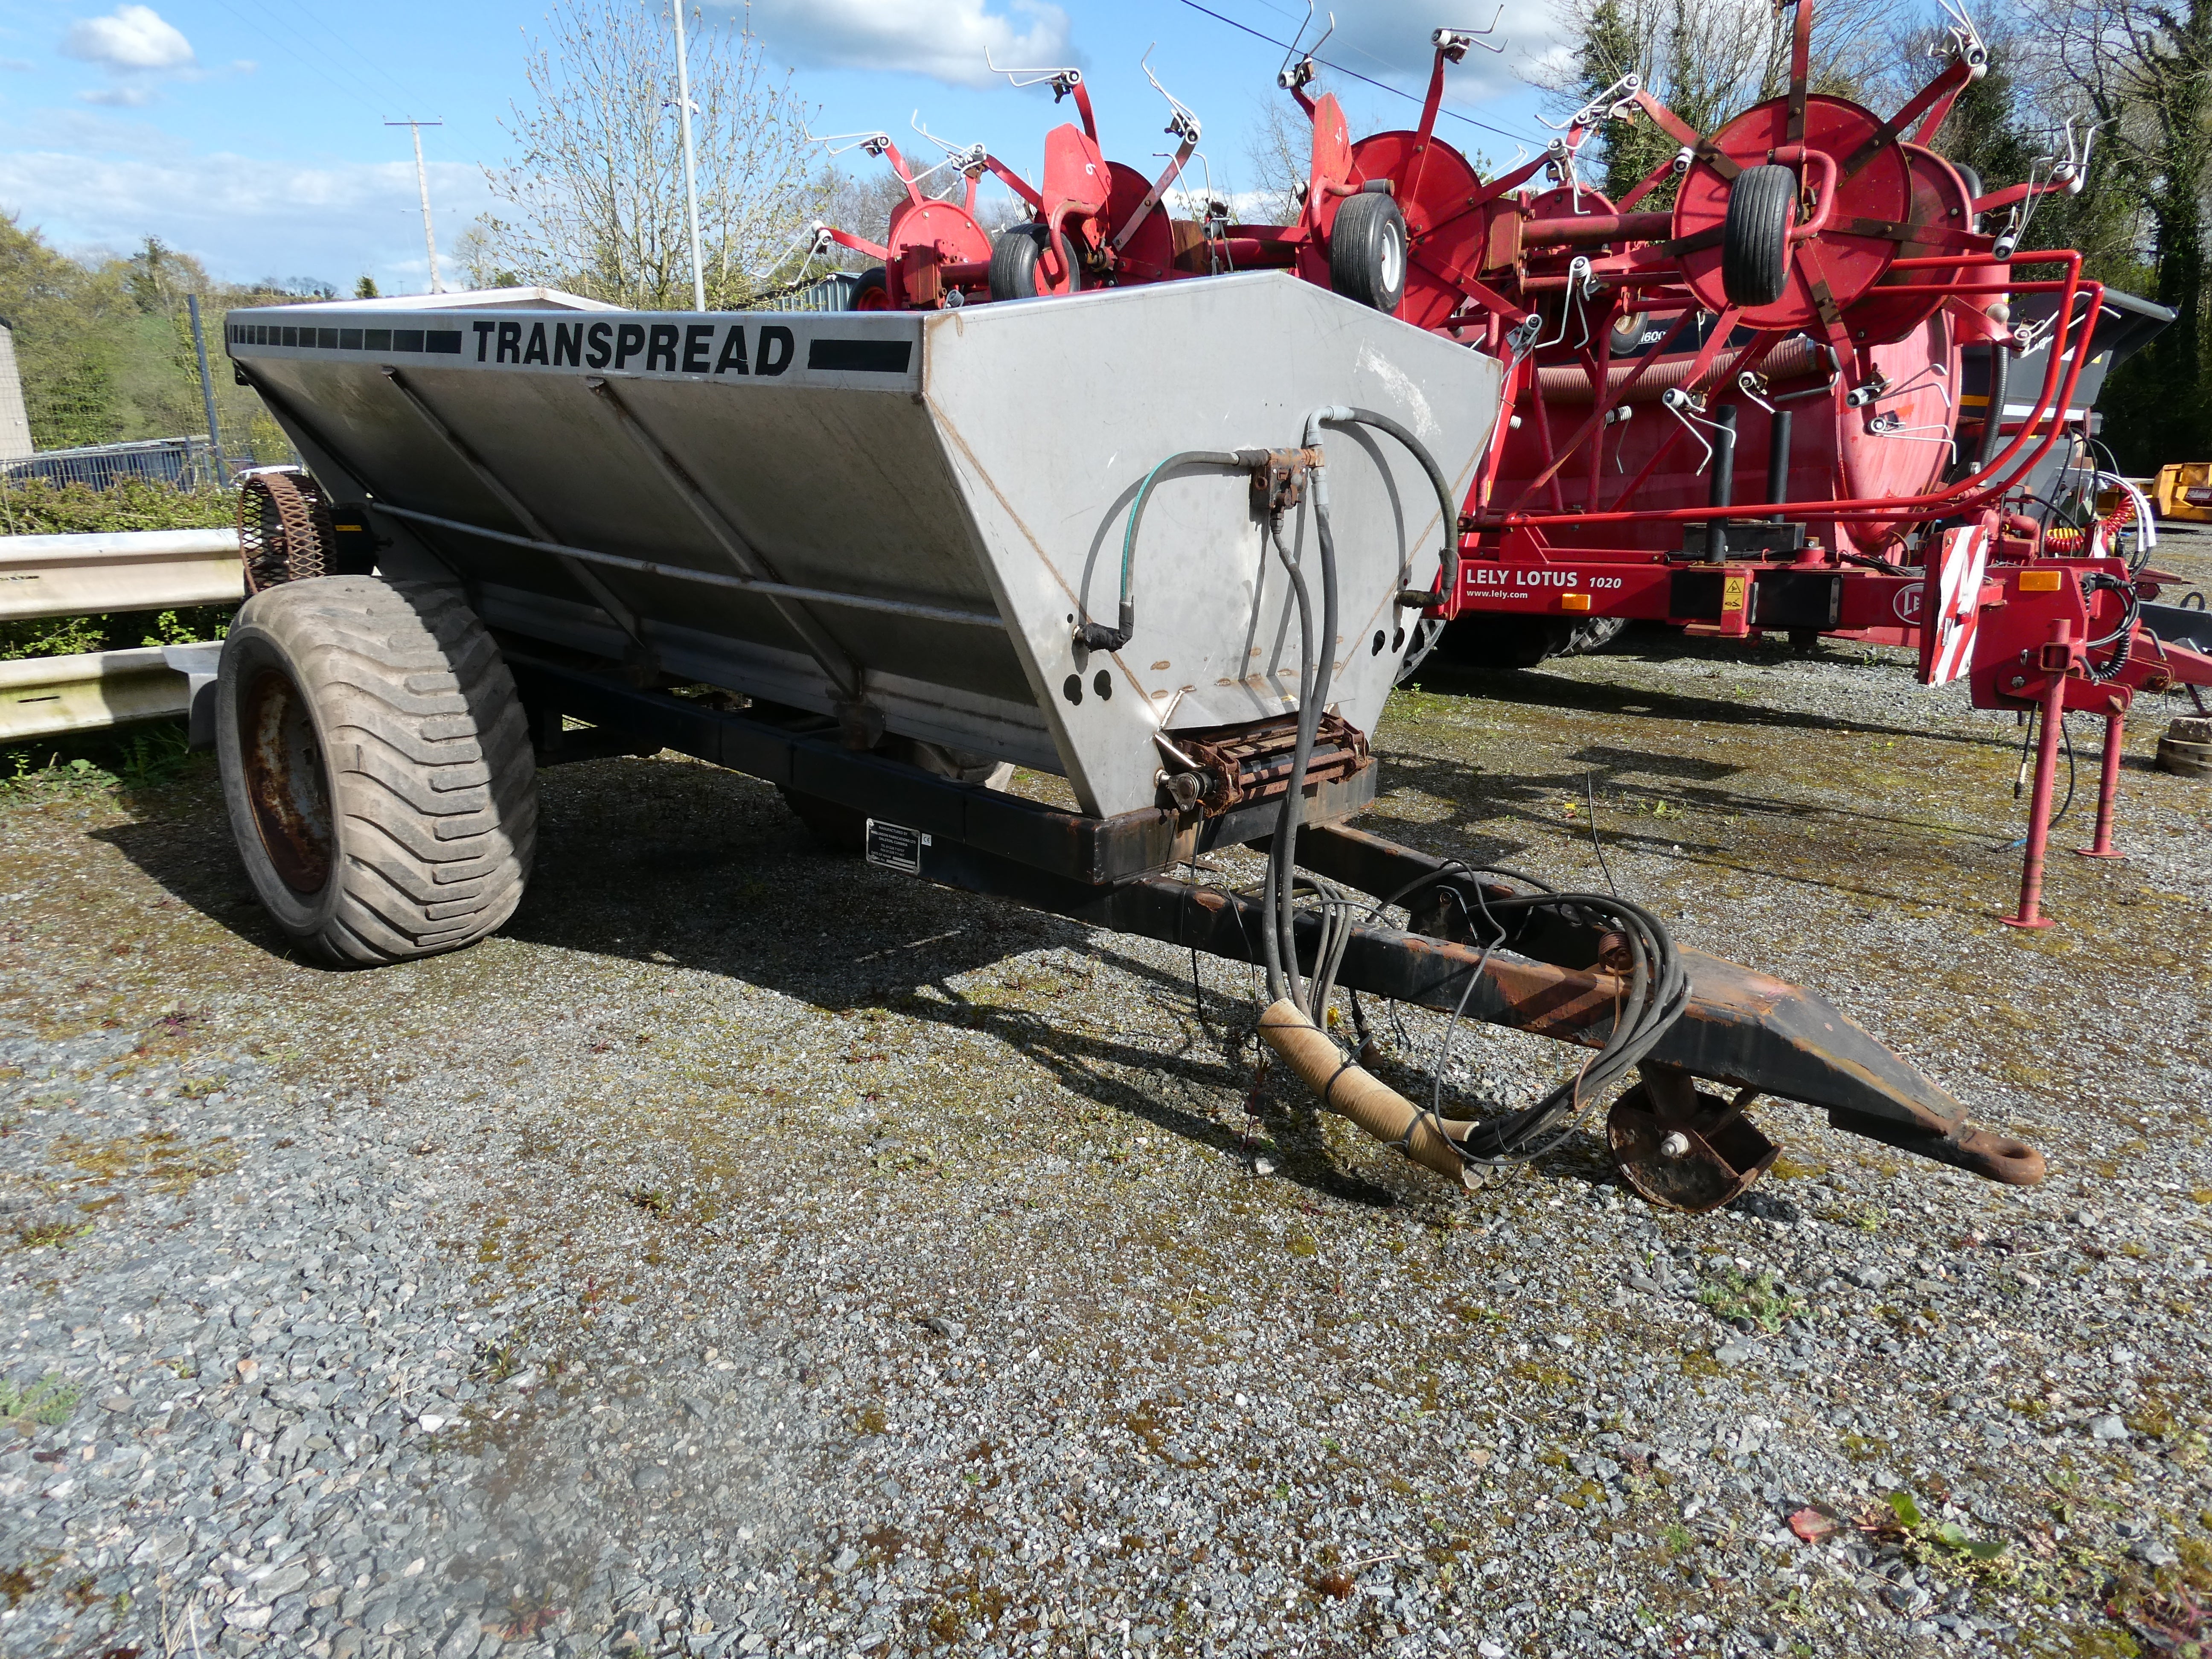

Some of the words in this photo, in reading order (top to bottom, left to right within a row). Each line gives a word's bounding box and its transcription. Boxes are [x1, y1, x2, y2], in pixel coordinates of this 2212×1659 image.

[473, 321, 794, 376] TRANSPREAD
[1467, 569, 1509, 584] LELY
[1516, 570, 1577, 587] LOTUS
[1589, 577, 1622, 588] 1020
[1467, 590, 1528, 599] www.lely.com
[879, 826, 903, 835] MANUFACTURED
[888, 834, 910, 843] FABRICATIONS
